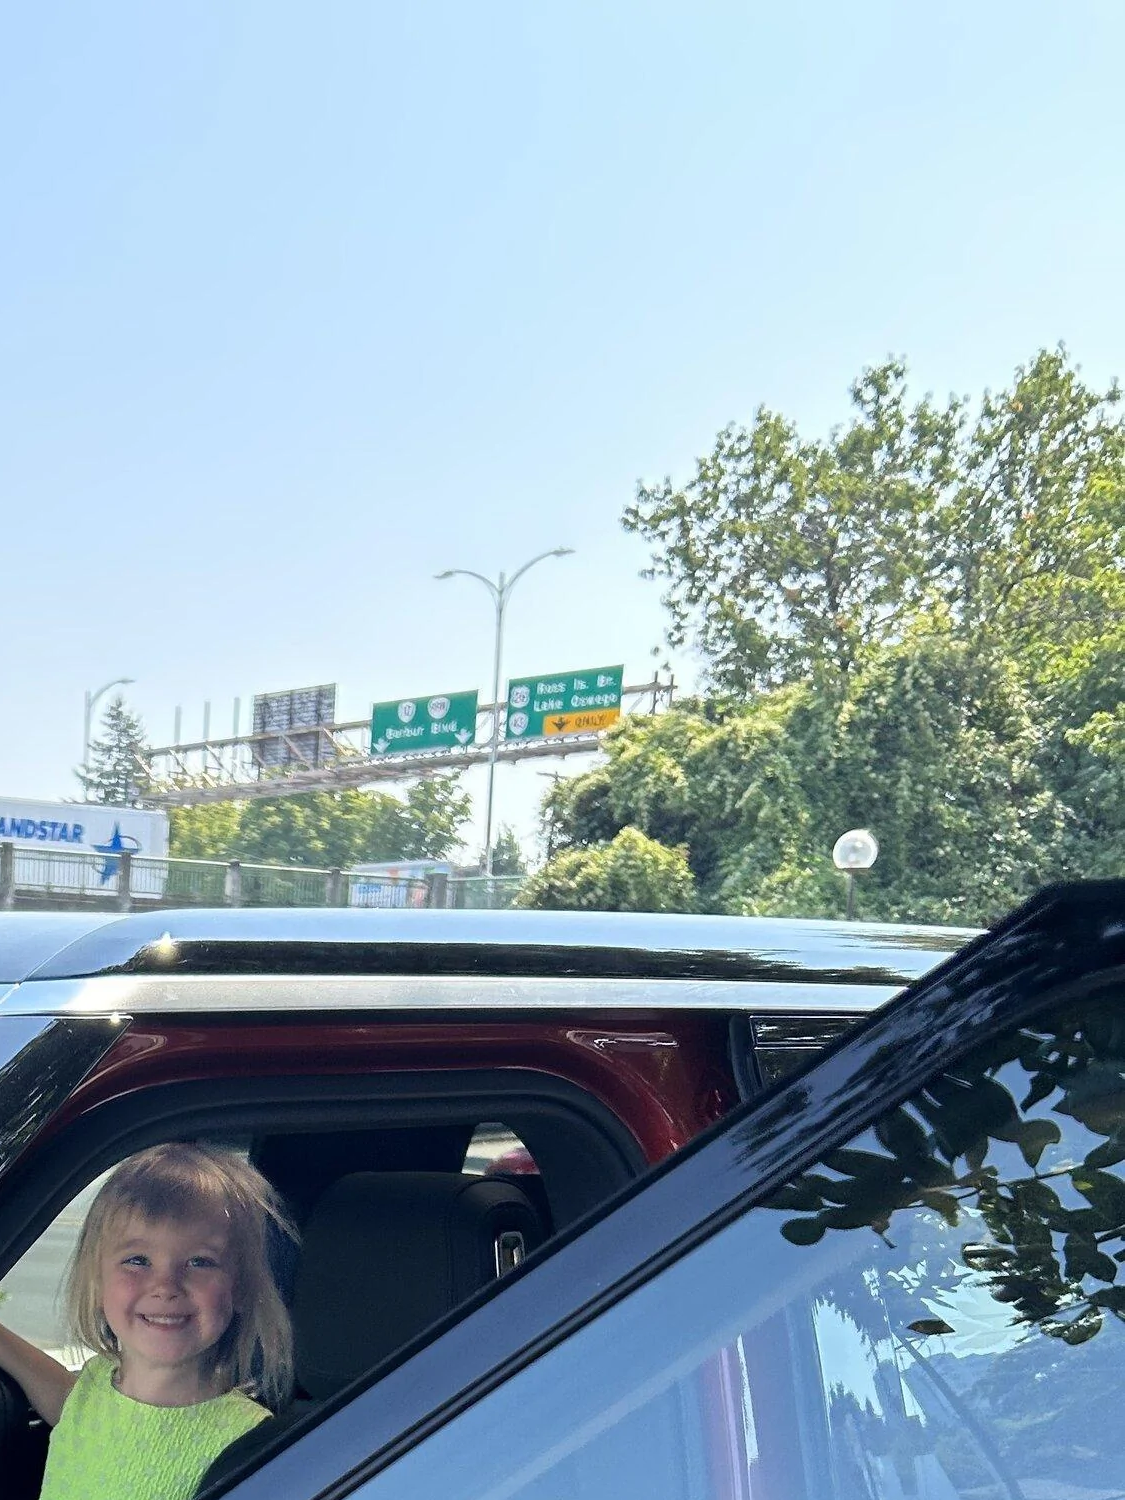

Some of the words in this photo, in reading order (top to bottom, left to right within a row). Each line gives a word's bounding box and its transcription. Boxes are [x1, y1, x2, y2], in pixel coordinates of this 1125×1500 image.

[537, 682, 567, 695] Ross
[534, 698, 563, 712] Lake
[571, 693, 618, 707] Oswego
[575, 714, 605, 728] ONLY
